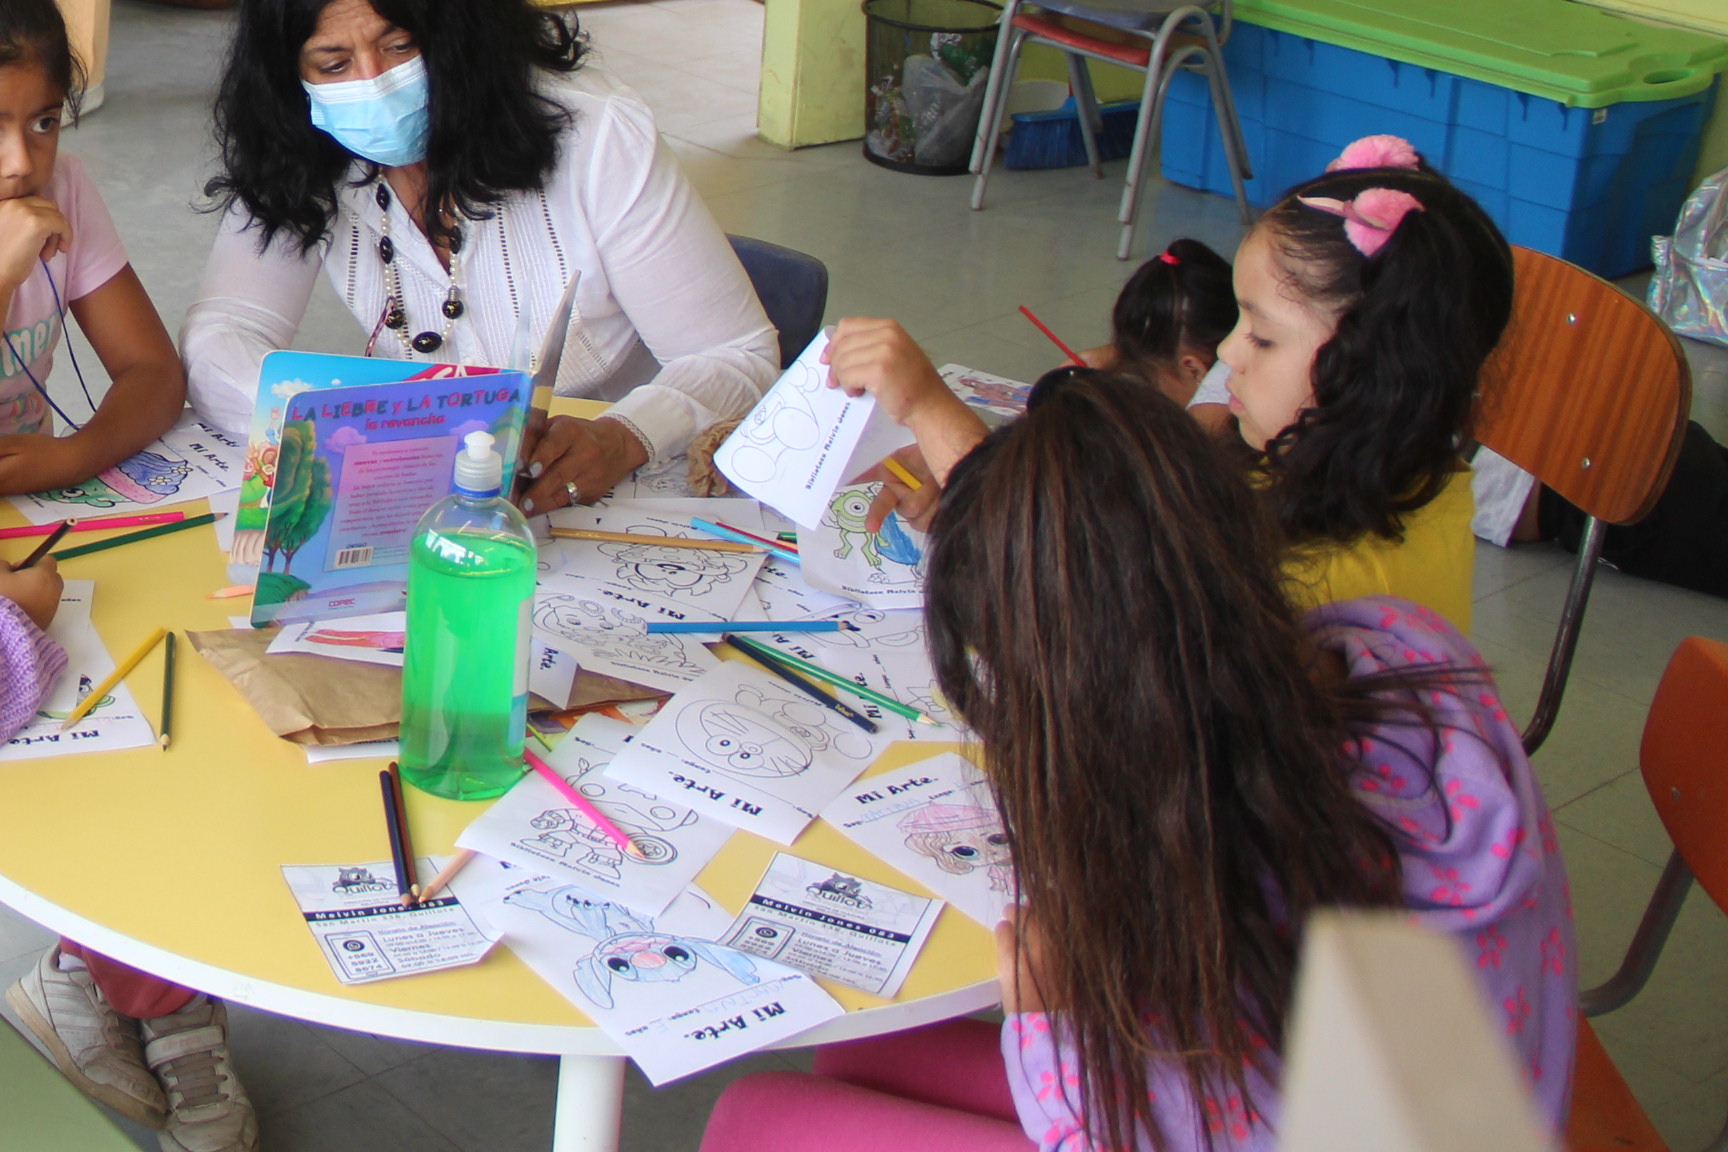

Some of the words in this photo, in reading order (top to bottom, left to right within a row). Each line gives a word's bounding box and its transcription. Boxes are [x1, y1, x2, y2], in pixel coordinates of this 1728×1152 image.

[292, 406, 316, 421] LA
[322, 399, 389, 420] LIEBRE
[406, 396, 432, 412] LA
[436, 388, 521, 409] TORTUGA
[366, 418, 377, 430] la
[380, 414, 446, 429] revancha
[824, 425, 839, 451] Melvin
[837, 402, 851, 424] Jones
[657, 606, 687, 621] Mi
[862, 704, 883, 720] Mi
[69, 729, 101, 740] Mi
[668, 770, 727, 801] Arte.
[854, 790, 886, 805] Mi
[886, 776, 940, 796] Arte.
[729, 797, 764, 817] Mi
[315, 908, 366, 920] Melvin
[761, 898, 813, 918] Melvin
[818, 914, 863, 932] Jones
[382, 934, 414, 943] Lunes
[427, 927, 465, 937] Jueves
[389, 943, 432, 953] Viernes
[797, 938, 829, 951] Lunes
[843, 950, 882, 966] Jueves
[750, 1000, 787, 1023] Mi
[683, 1014, 749, 1041] Arte.
